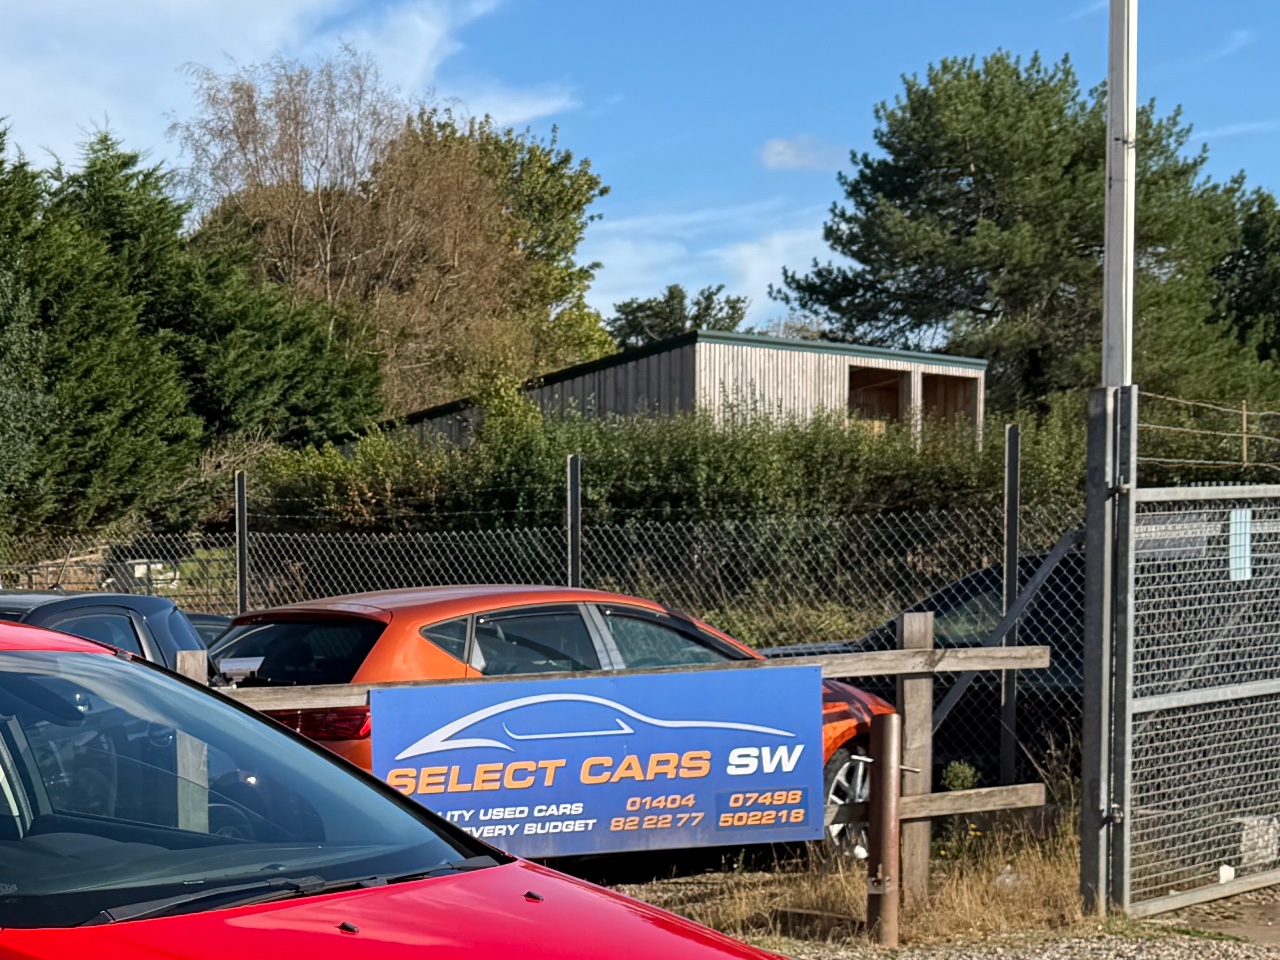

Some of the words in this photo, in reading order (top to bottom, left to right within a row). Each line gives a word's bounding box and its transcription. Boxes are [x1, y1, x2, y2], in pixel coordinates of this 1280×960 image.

[386, 758, 567, 796] SELECT
[579, 750, 712, 784] CARS
[726, 744, 805, 776] SW
[626, 794, 696, 811] 01404
[729, 790, 802, 808] 07498
[479, 806, 529, 820] USED
[533, 803, 584, 817] CARS
[718, 809, 805, 827] 502218
[523, 819, 597, 835] BUDGET
